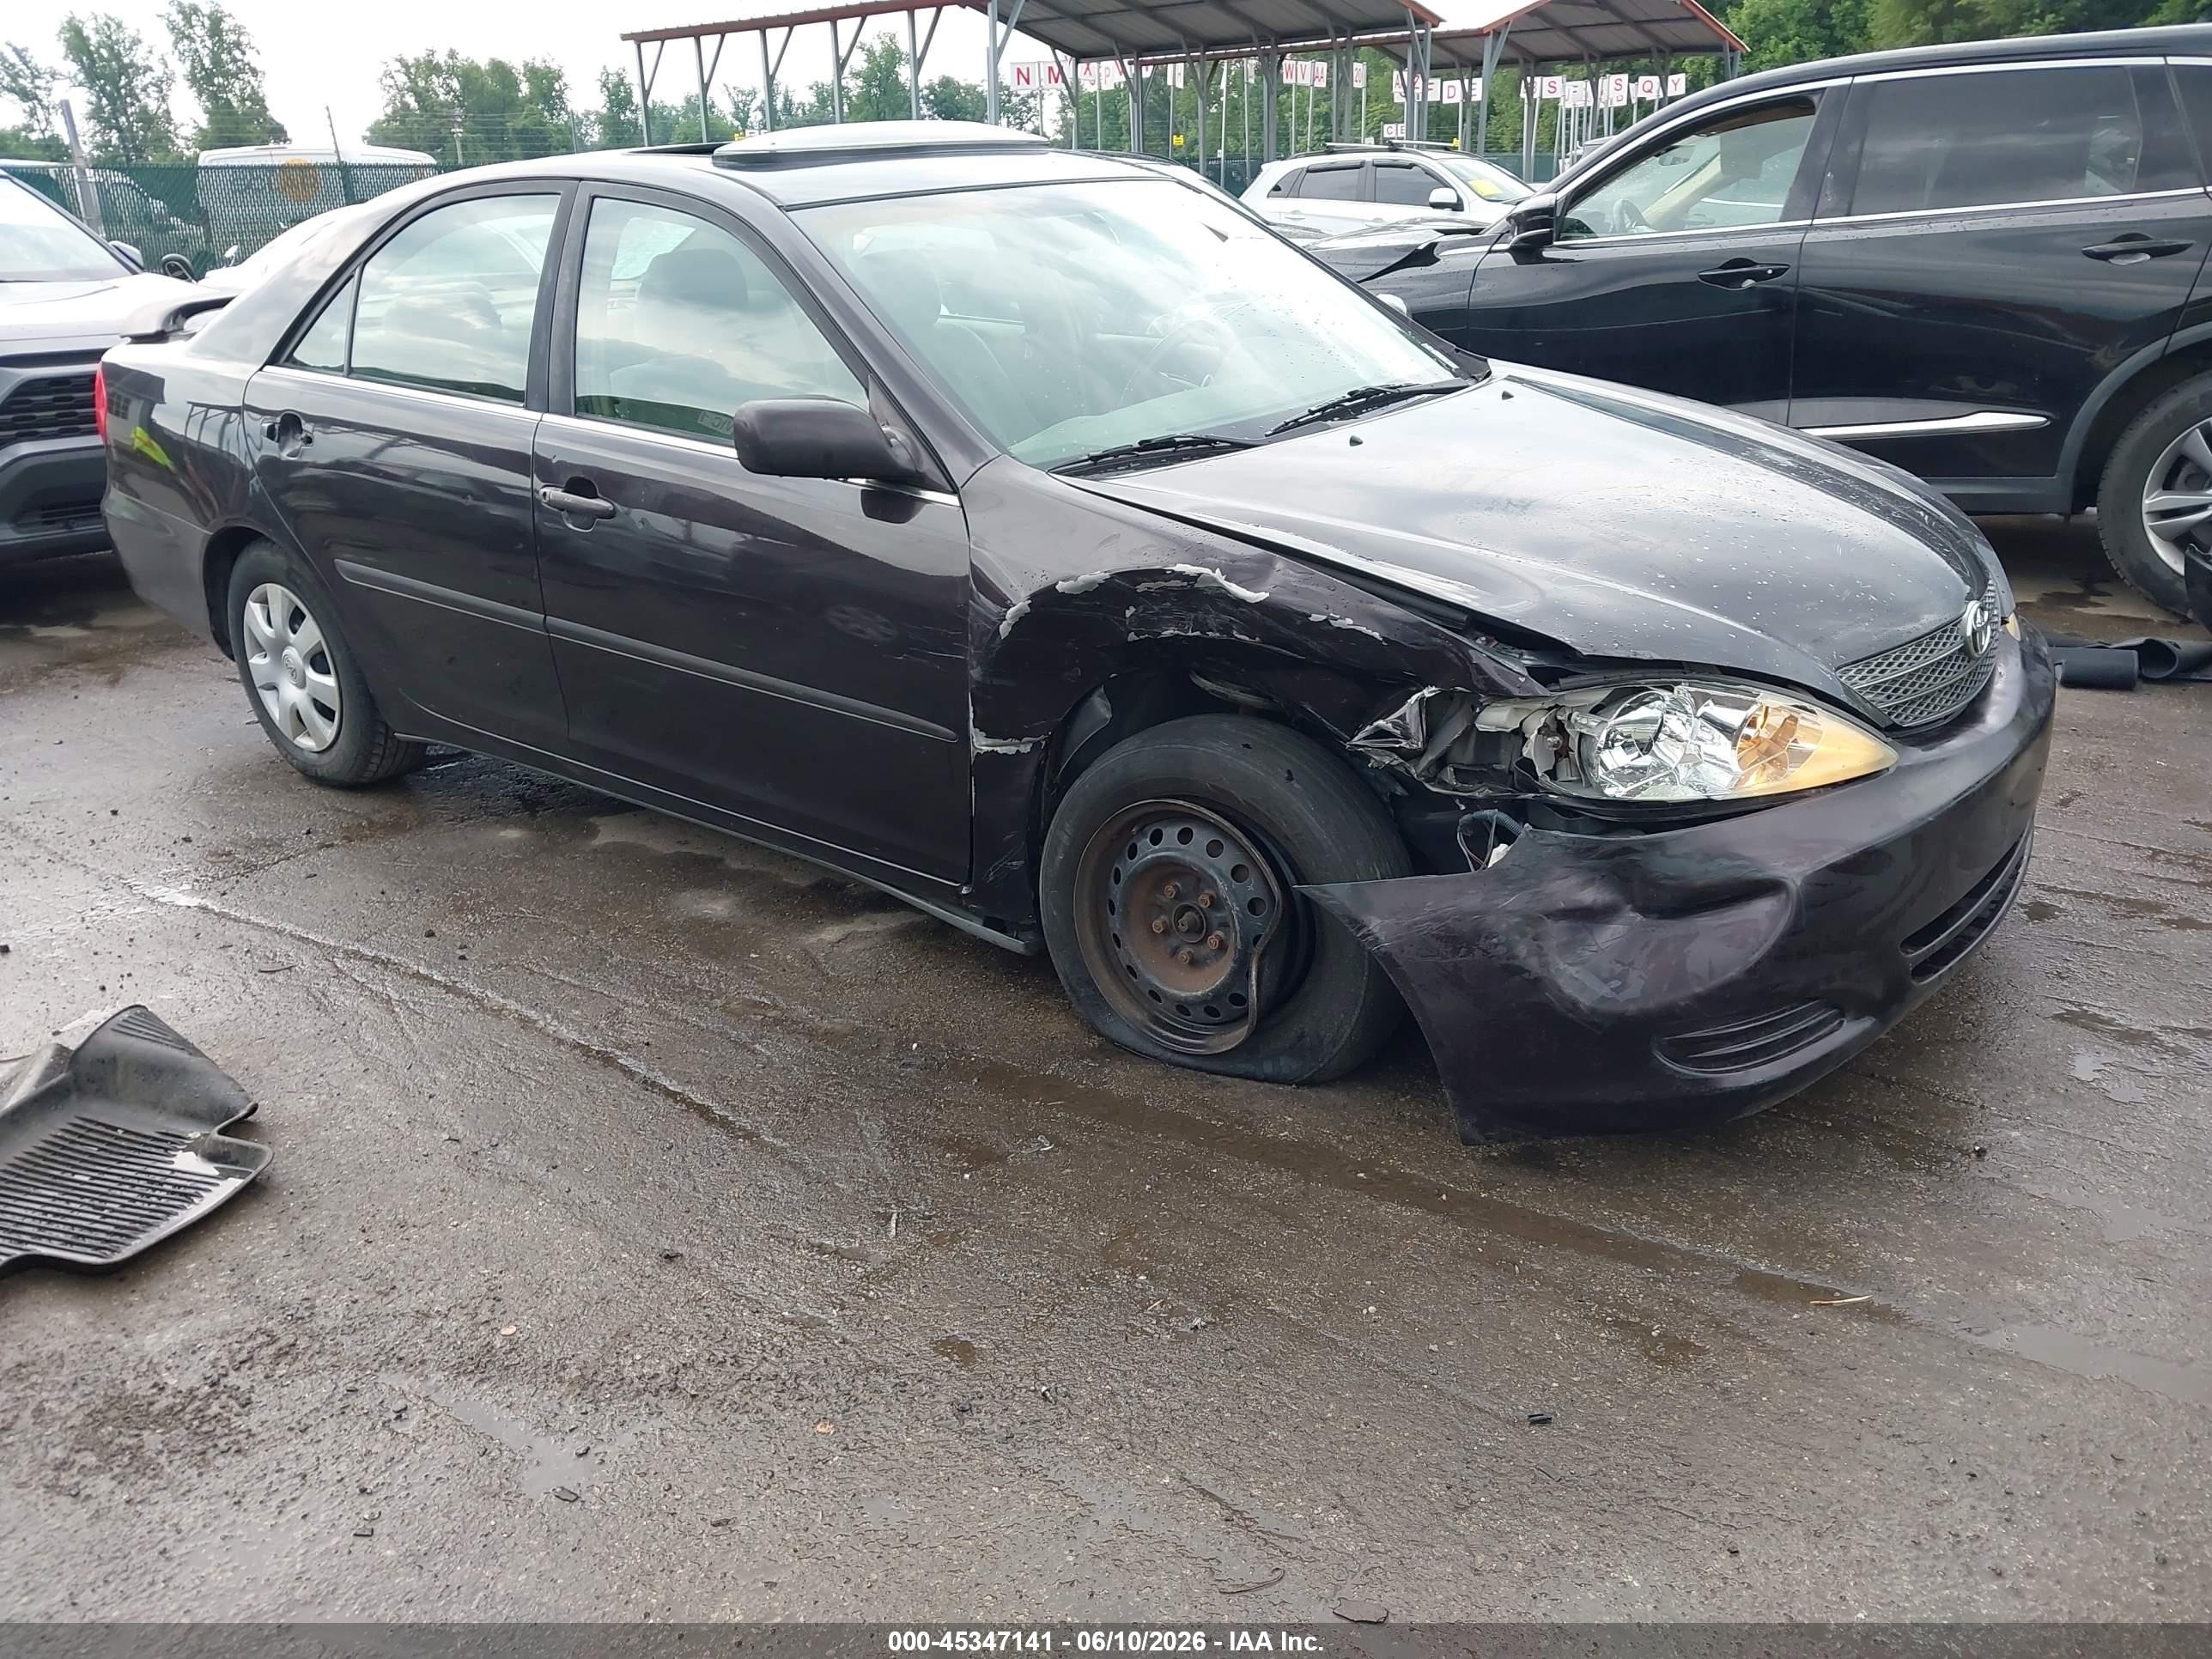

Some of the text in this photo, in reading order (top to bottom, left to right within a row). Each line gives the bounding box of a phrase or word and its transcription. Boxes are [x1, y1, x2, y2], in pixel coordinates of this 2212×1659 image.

[1017, 67, 1030, 85] N
[1285, 63, 1295, 80] W
[1300, 64, 1307, 80] V
[1547, 81, 1557, 94] S
[1614, 78, 1623, 91] S
[1642, 80, 1654, 94] Q
[1672, 78, 1680, 91] Y
[1447, 85, 1456, 99] D
[1386, 126, 1394, 135] C
